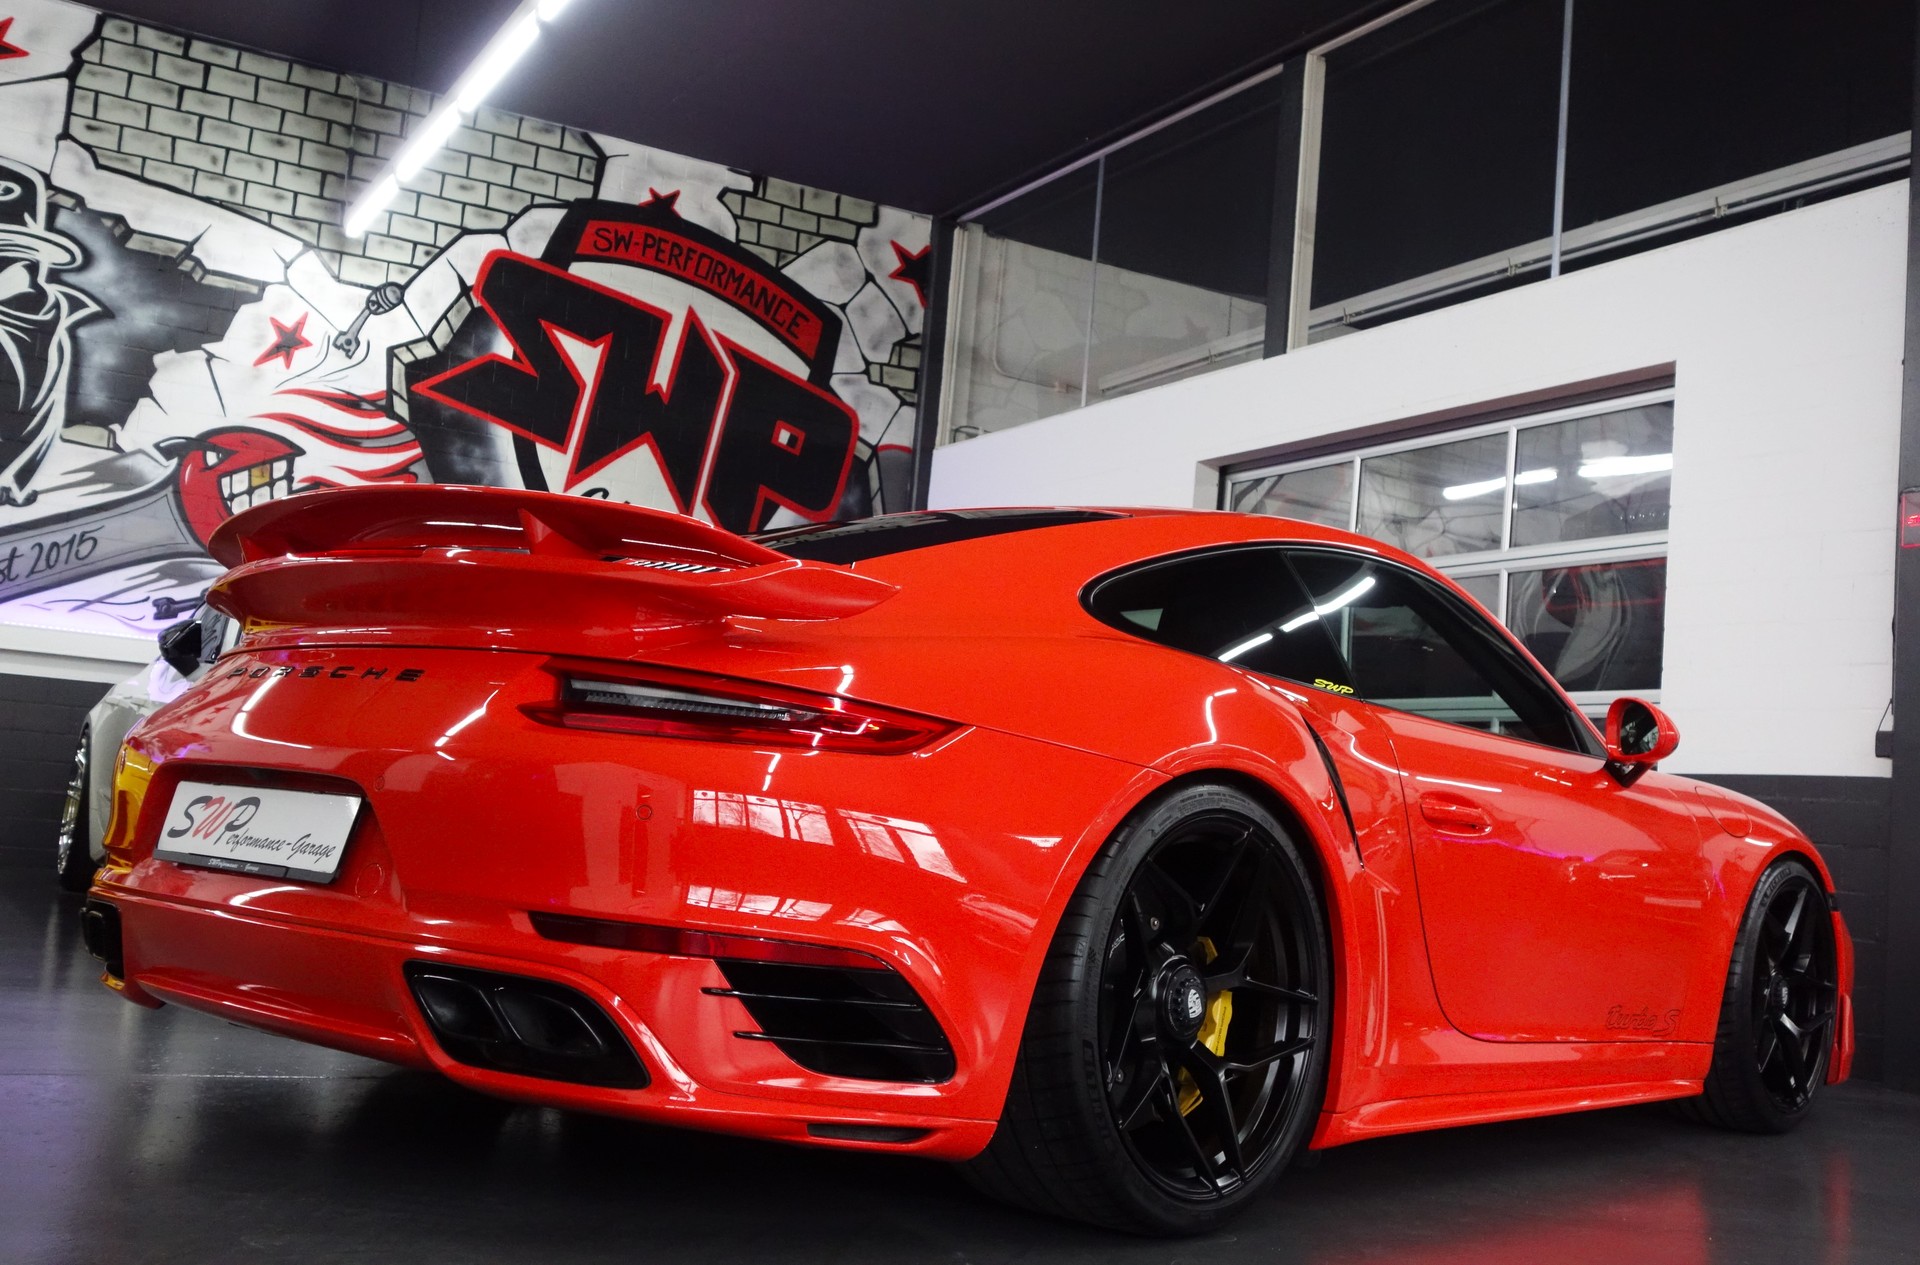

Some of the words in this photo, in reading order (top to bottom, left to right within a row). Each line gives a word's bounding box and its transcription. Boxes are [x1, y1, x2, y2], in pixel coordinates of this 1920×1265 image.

[592, 227, 810, 340] SW-PERFORMANCE
[410, 249, 860, 533] SWP
[25, 525, 105, 578] 2015
[226, 665, 425, 682] PORSCHE
[1313, 678, 1354, 695] SWP
[1652, 1008, 1681, 1037] S
